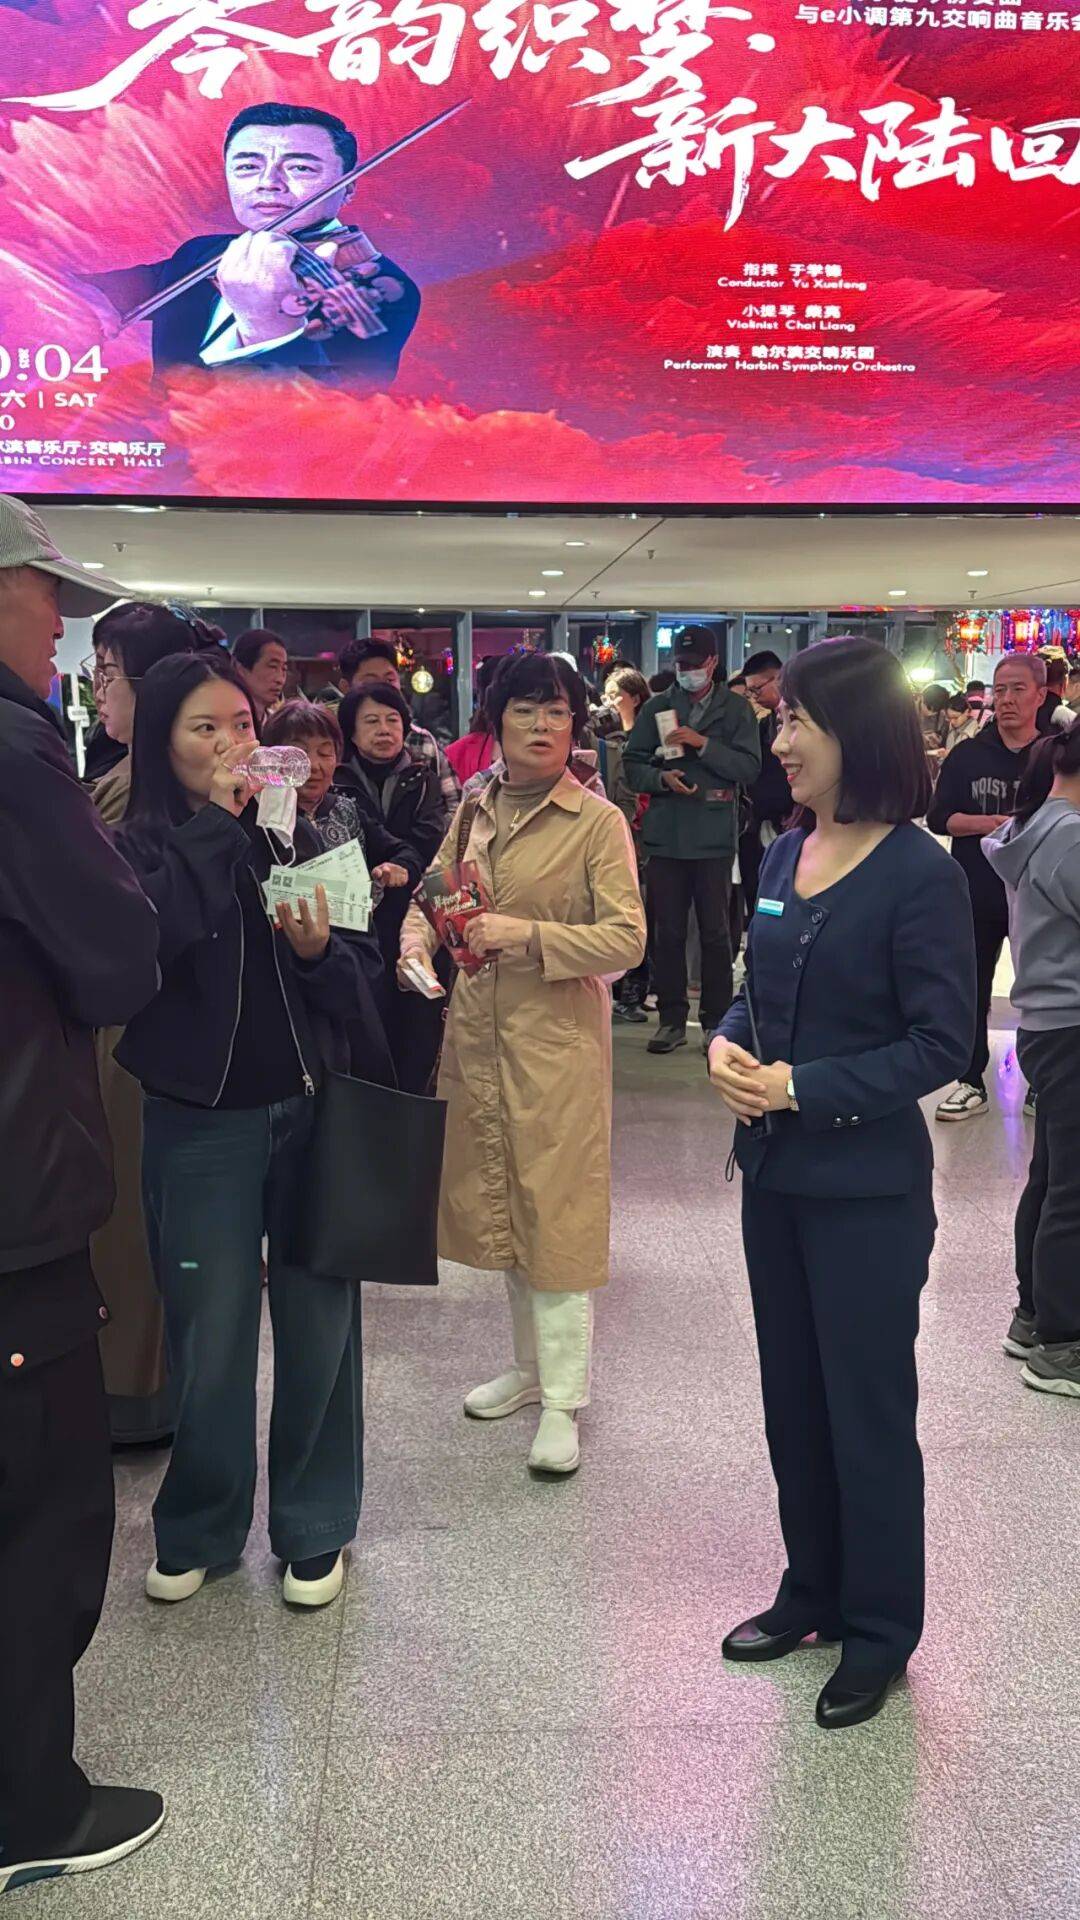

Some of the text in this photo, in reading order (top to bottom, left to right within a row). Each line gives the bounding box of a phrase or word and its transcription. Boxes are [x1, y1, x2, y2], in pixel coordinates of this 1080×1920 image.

[743, 263, 778, 276] 指挥
[717, 277, 867, 291] Conductor Yu Xuefeng
[742, 304, 797, 317] 小提琴
[727, 319, 855, 332] Violinist Chai Liang
[707, 345, 875, 359] 演奏 哈尔滨交响乐团
[664, 359, 915, 373] Performer Harbin Symphony Orchestra
[54, 393, 97, 407] SAT
[0, 439, 166, 456] 滨音乐厅·交响乐厅
[0, 455, 164, 467] BIN CONCERT HALL
[971, 777, 1007, 799] NOISY
